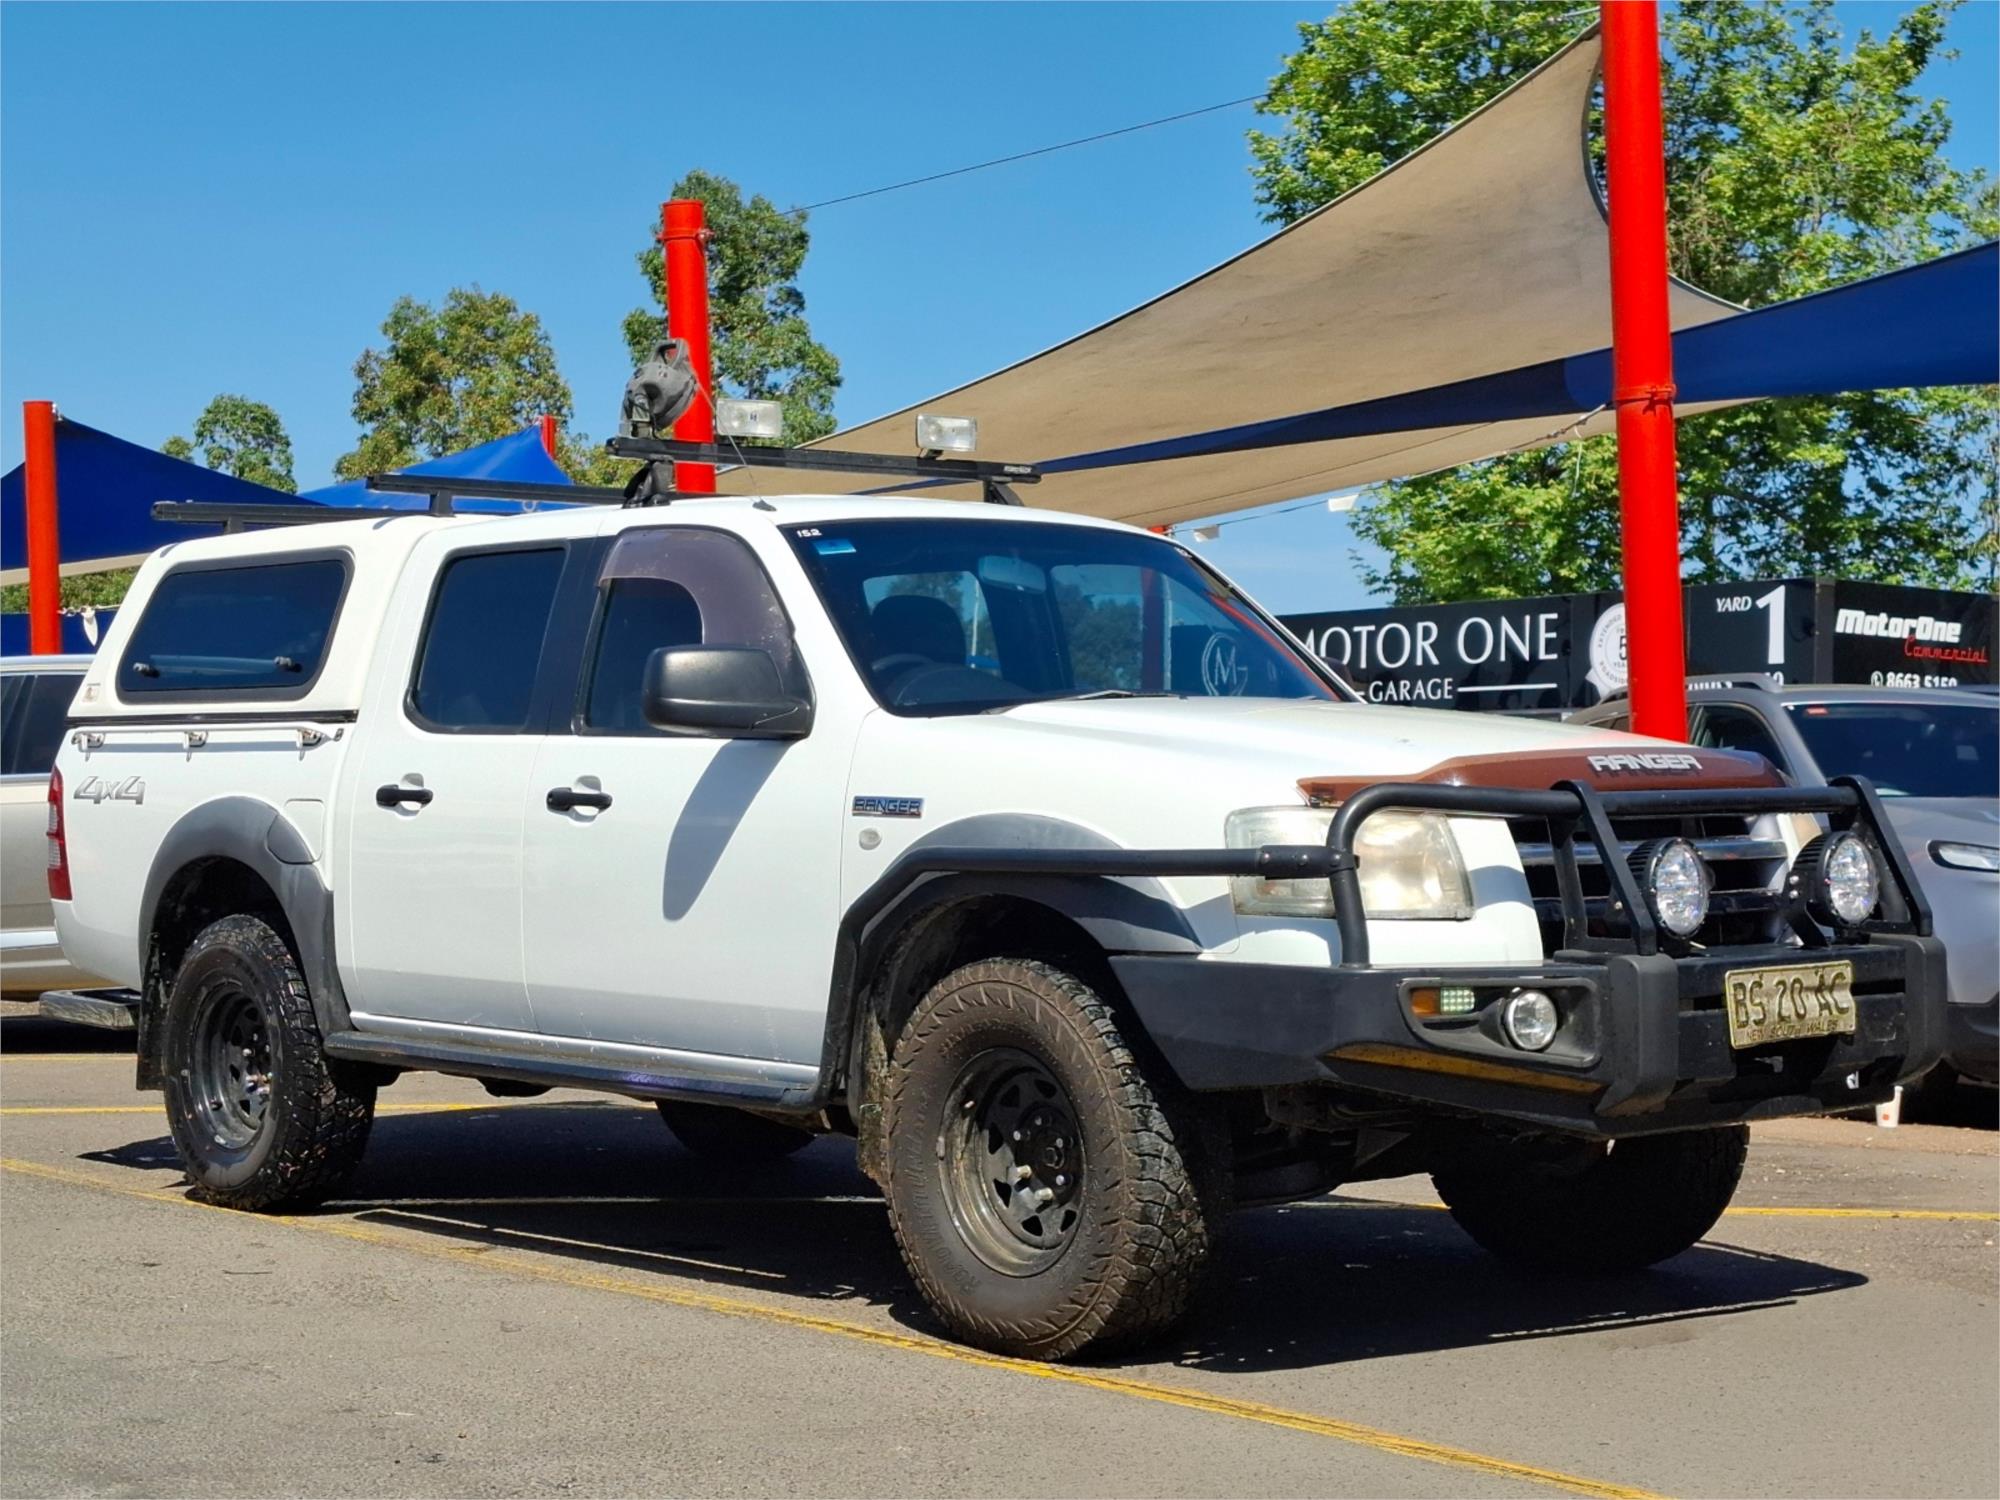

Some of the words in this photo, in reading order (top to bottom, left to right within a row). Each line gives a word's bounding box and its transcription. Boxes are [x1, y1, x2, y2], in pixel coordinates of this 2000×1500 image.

[1716, 595, 1752, 613] YARD
[1755, 584, 1786, 665] 1
[1835, 608, 1962, 643] MotorOne
[1457, 612, 1559, 665] ONE
[1904, 634, 1988, 663] Commercial
[1369, 678, 1454, 702] GARAGE
[1886, 671, 1921, 689] 8663
[1587, 754, 1703, 772] RANGER
[854, 798, 921, 813] RANGER
